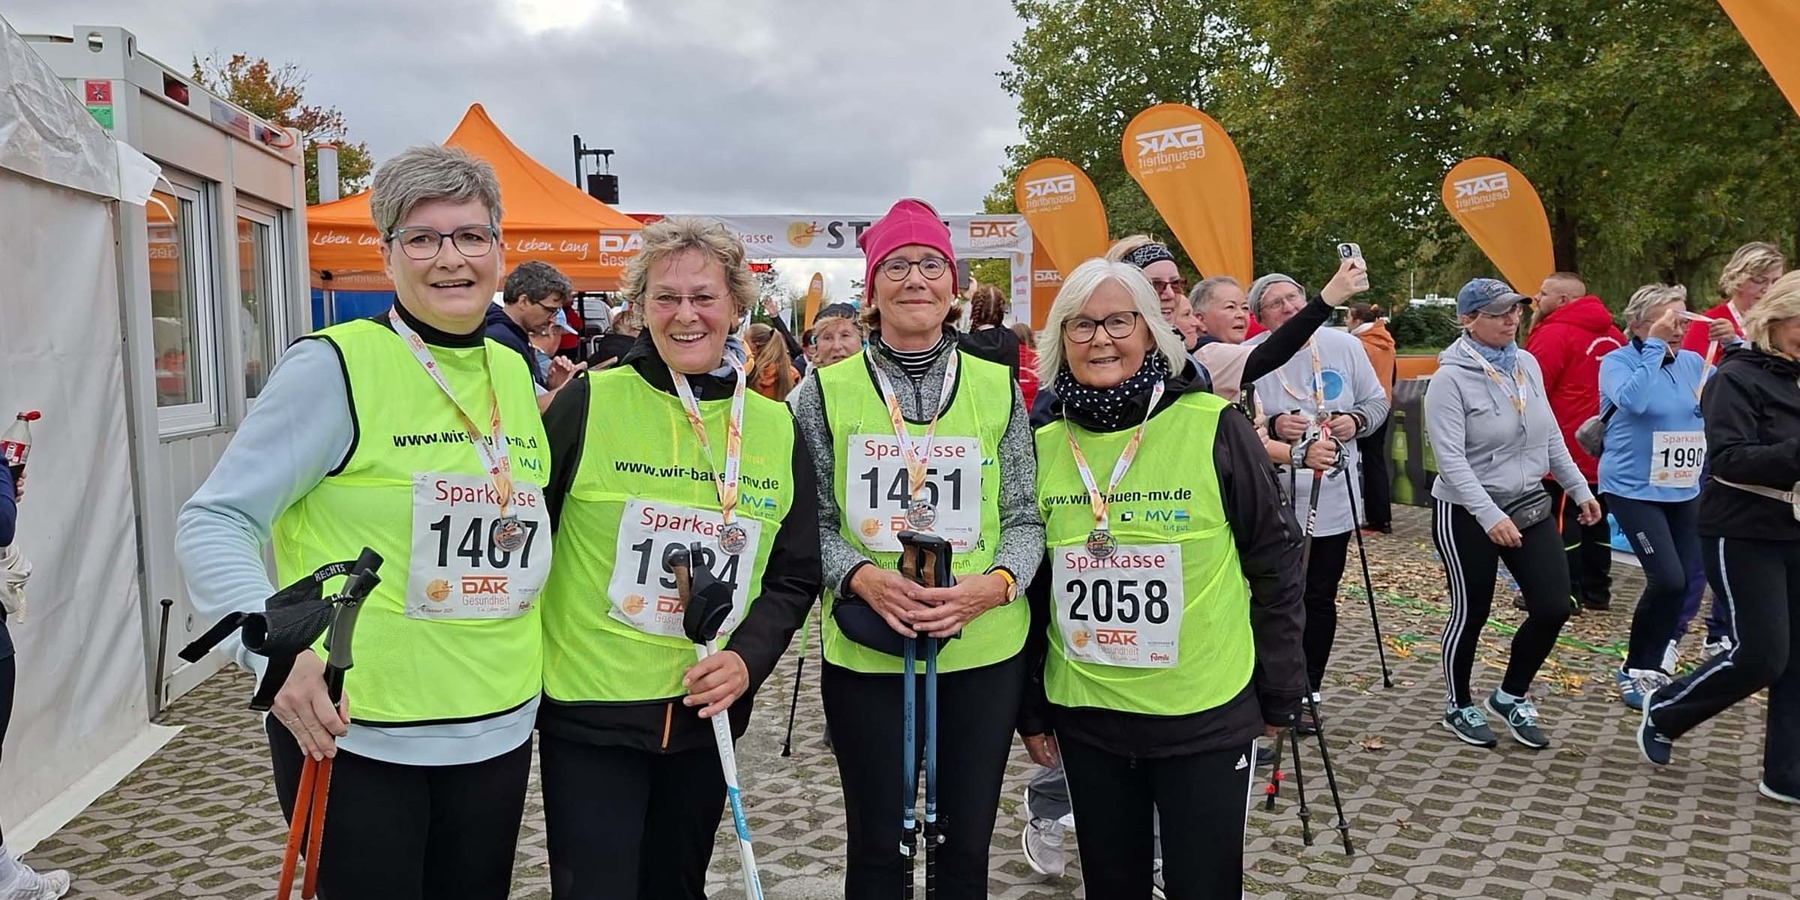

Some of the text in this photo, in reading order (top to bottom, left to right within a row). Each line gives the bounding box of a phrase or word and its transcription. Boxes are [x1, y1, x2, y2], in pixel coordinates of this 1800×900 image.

[312, 231, 352, 246] Leben
[738, 232, 774, 244] kasse
[969, 221, 1018, 238] DAK
[517, 238, 554, 252] Leben
[559, 240, 589, 260] Lang
[600, 230, 642, 253] DA
[1033, 270, 1063, 281] DAK
[864, 440, 966, 460] Spaksse
[1660, 447, 1703, 468] 1990
[435, 480, 536, 507] Sparkse
[860, 467, 962, 511] 1451
[640, 507, 725, 538] Sparkas
[1145, 510, 1173, 522] MV
[1307, 504, 1317, 535] LEKI
[314, 563, 347, 582] RECHTS
[1065, 552, 1165, 573] Sparkasse
[461, 576, 509, 594] DAK
[462, 595, 510, 606] Gesundheit
[1066, 579, 1170, 624] 2058
[1096, 629, 1138, 646] DAK
